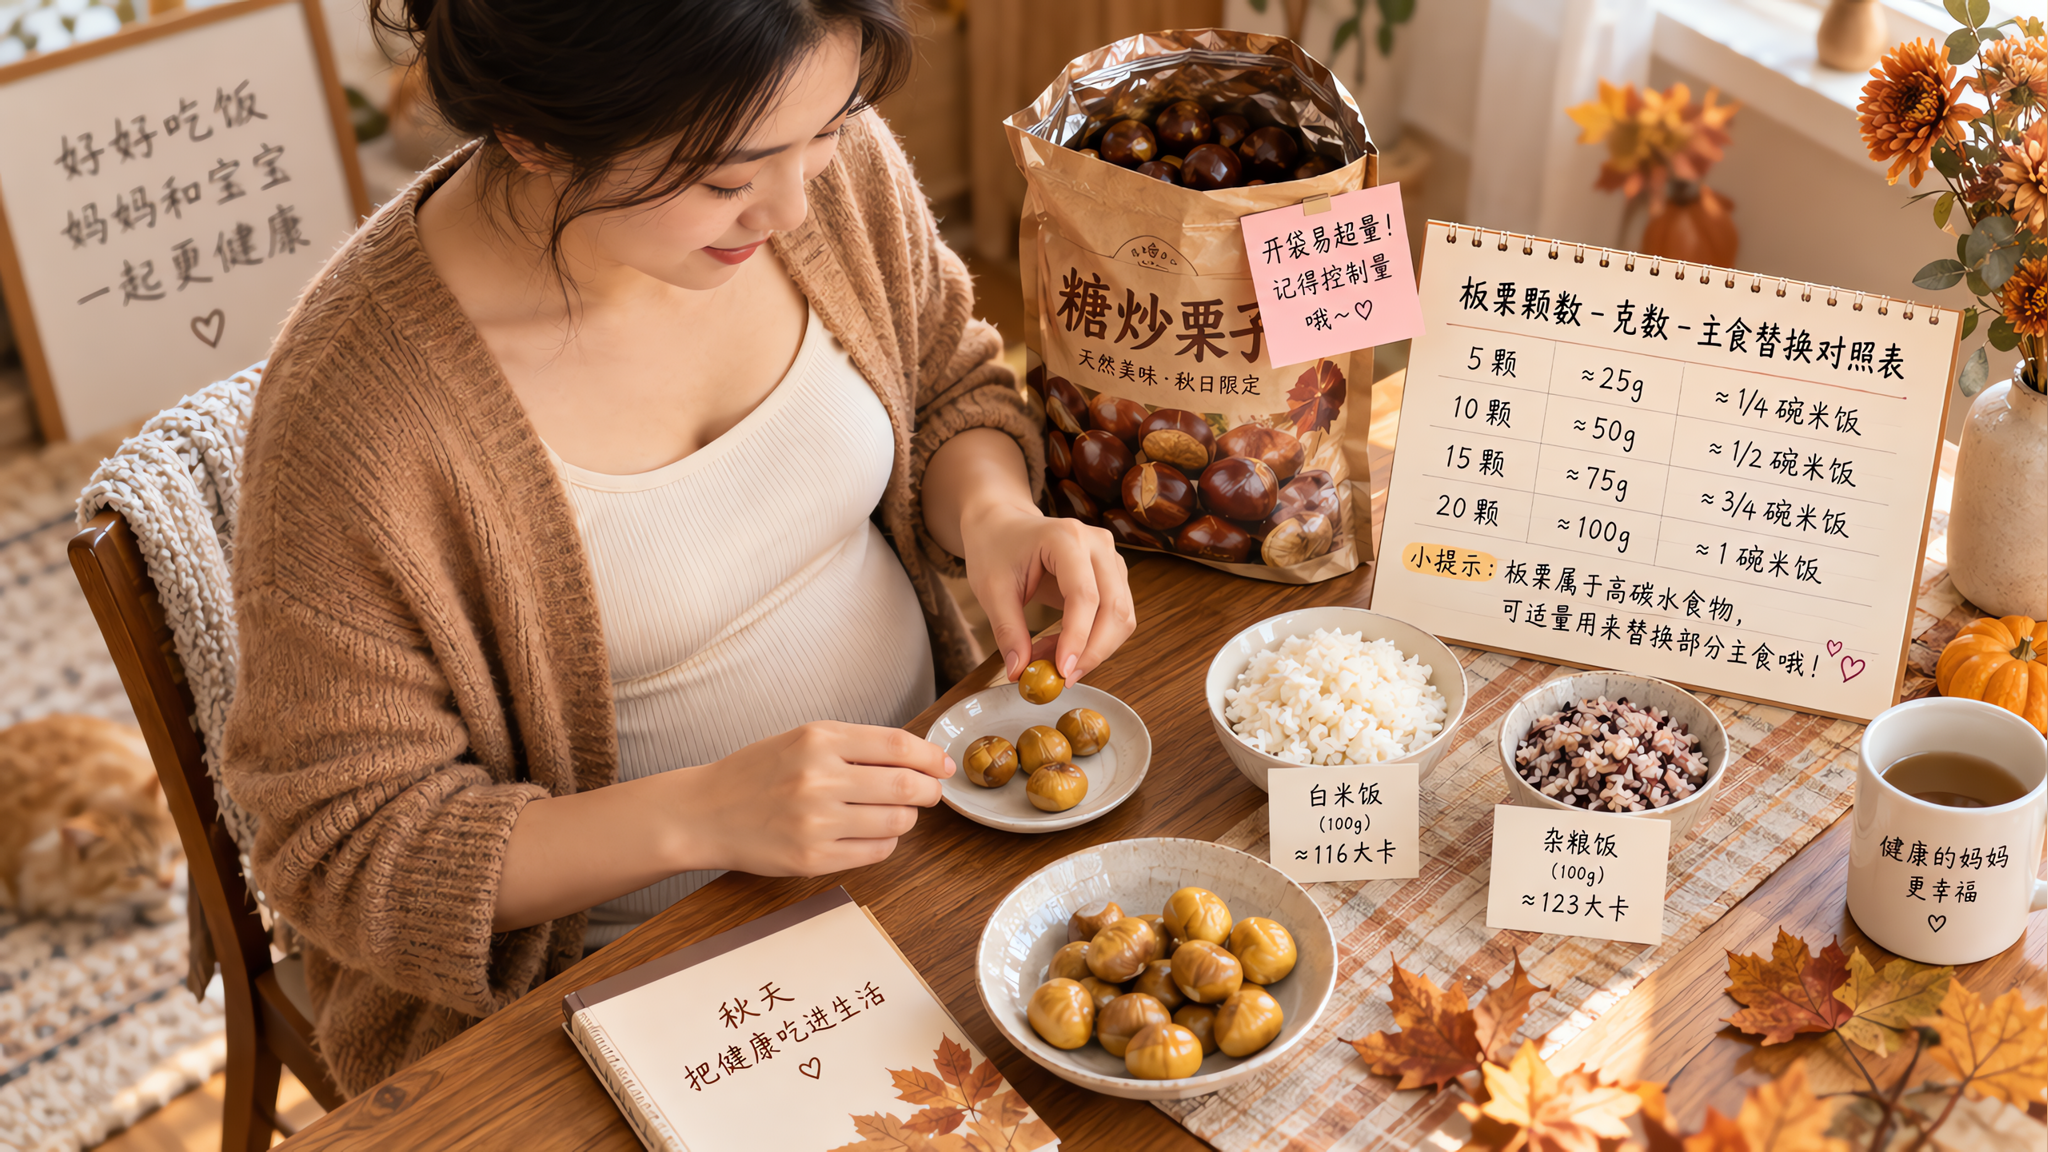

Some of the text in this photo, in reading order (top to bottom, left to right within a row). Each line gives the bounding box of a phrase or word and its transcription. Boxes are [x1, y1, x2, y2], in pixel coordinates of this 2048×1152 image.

[54, 79, 269, 180] 好好吃饭
[60, 142, 292, 250] 妈妈和宝宝
[77, 203, 312, 306] 一起更健康
[1262, 213, 1392, 265] 开袋易超量!
[1272, 252, 1393, 301] 记得控制量
[1502, 599, 1819, 678] 可适量用来替换部分主食哦!
[1310, 782, 1383, 808] 白米饭
[1319, 813, 1371, 836] (100g)
[1543, 826, 1619, 859] 杂粮饭
[1551, 862, 1605, 888] (100g)
[1879, 835, 2009, 870] 健康的妈妈
[1905, 876, 1978, 904] 更幸福
[719, 981, 796, 1030] 秋天
[684, 981, 886, 1092] 把健康吃进生活
